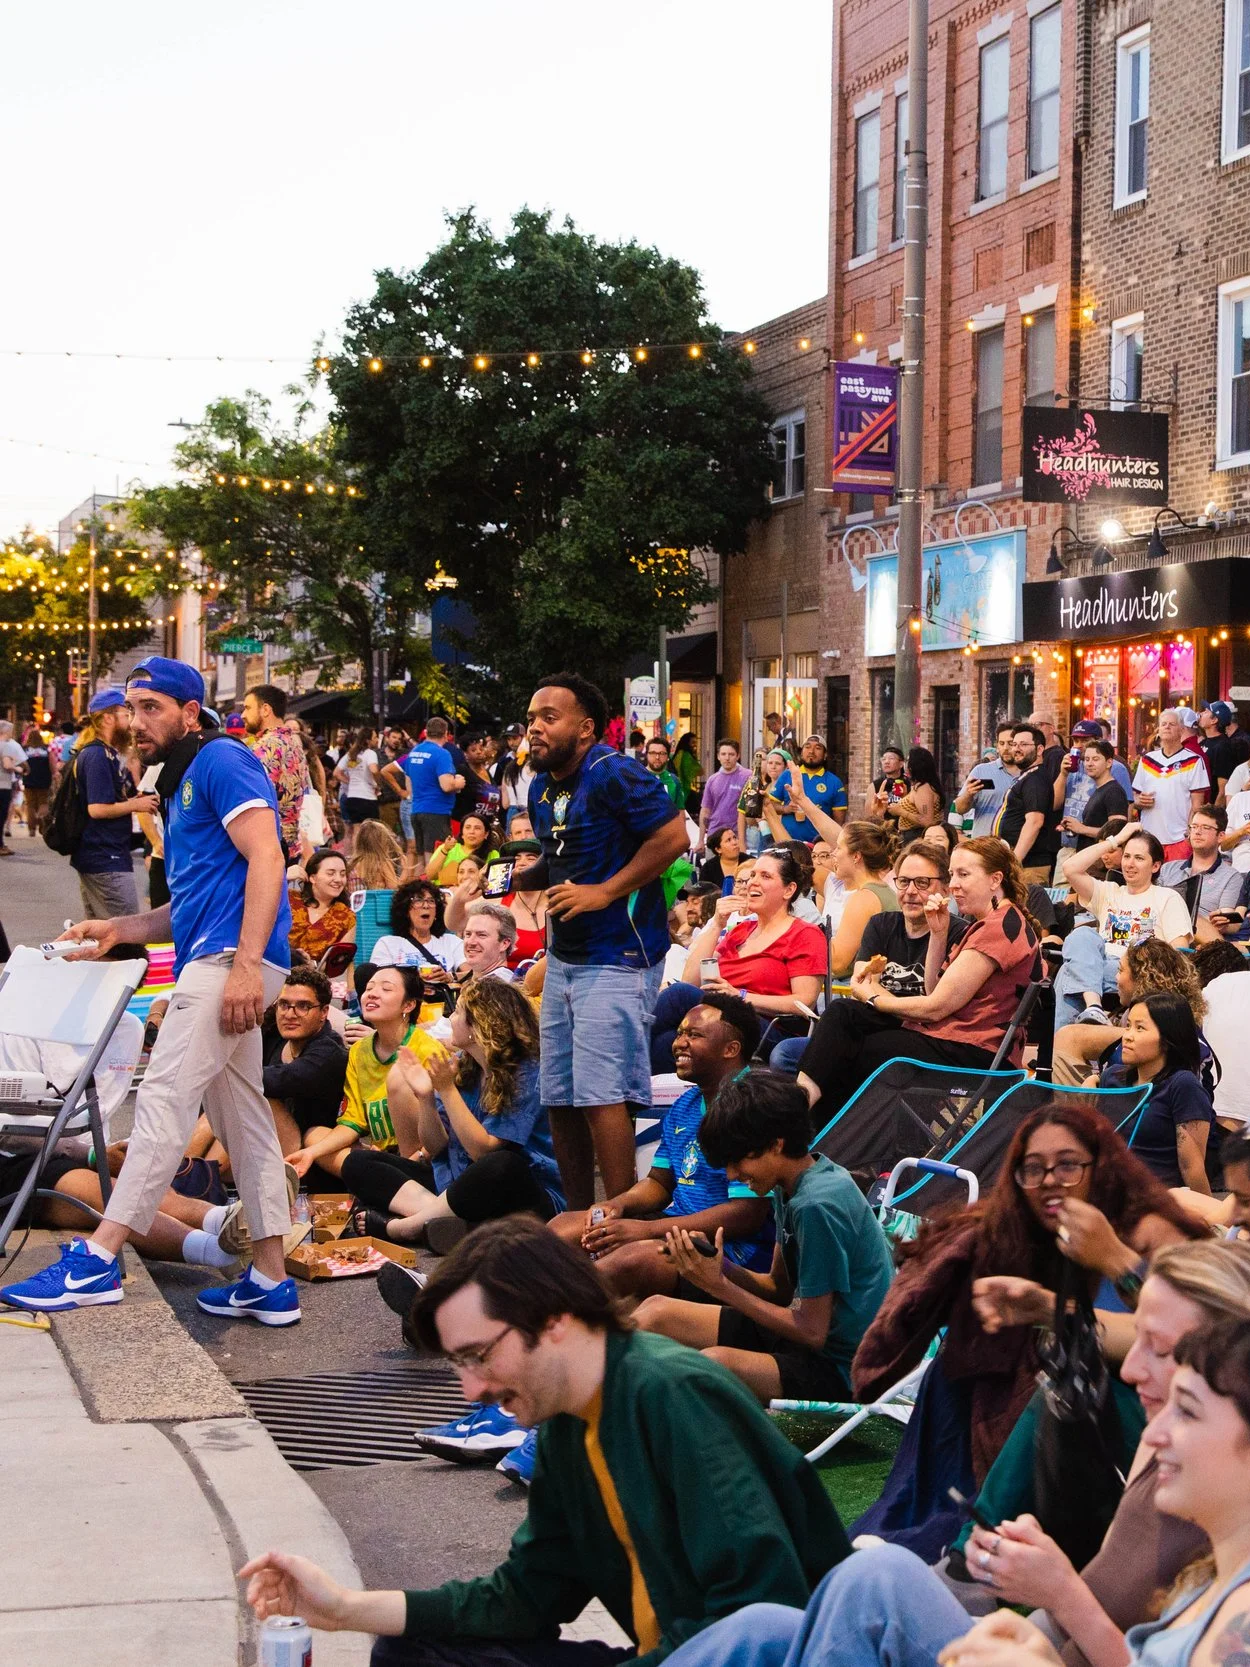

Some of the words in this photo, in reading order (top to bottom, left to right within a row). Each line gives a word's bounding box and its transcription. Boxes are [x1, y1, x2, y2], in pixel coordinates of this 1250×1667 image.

[840, 376, 865, 386] east
[840, 383, 893, 399] passyunk
[870, 393, 890, 403] ave
[1039, 450, 1160, 475] Headhunters
[1110, 477, 1132, 488] HAIR
[1133, 477, 1164, 491] DESIGN
[1060, 586, 1179, 629] Headhunters
[223, 643, 252, 653] PIERCE
